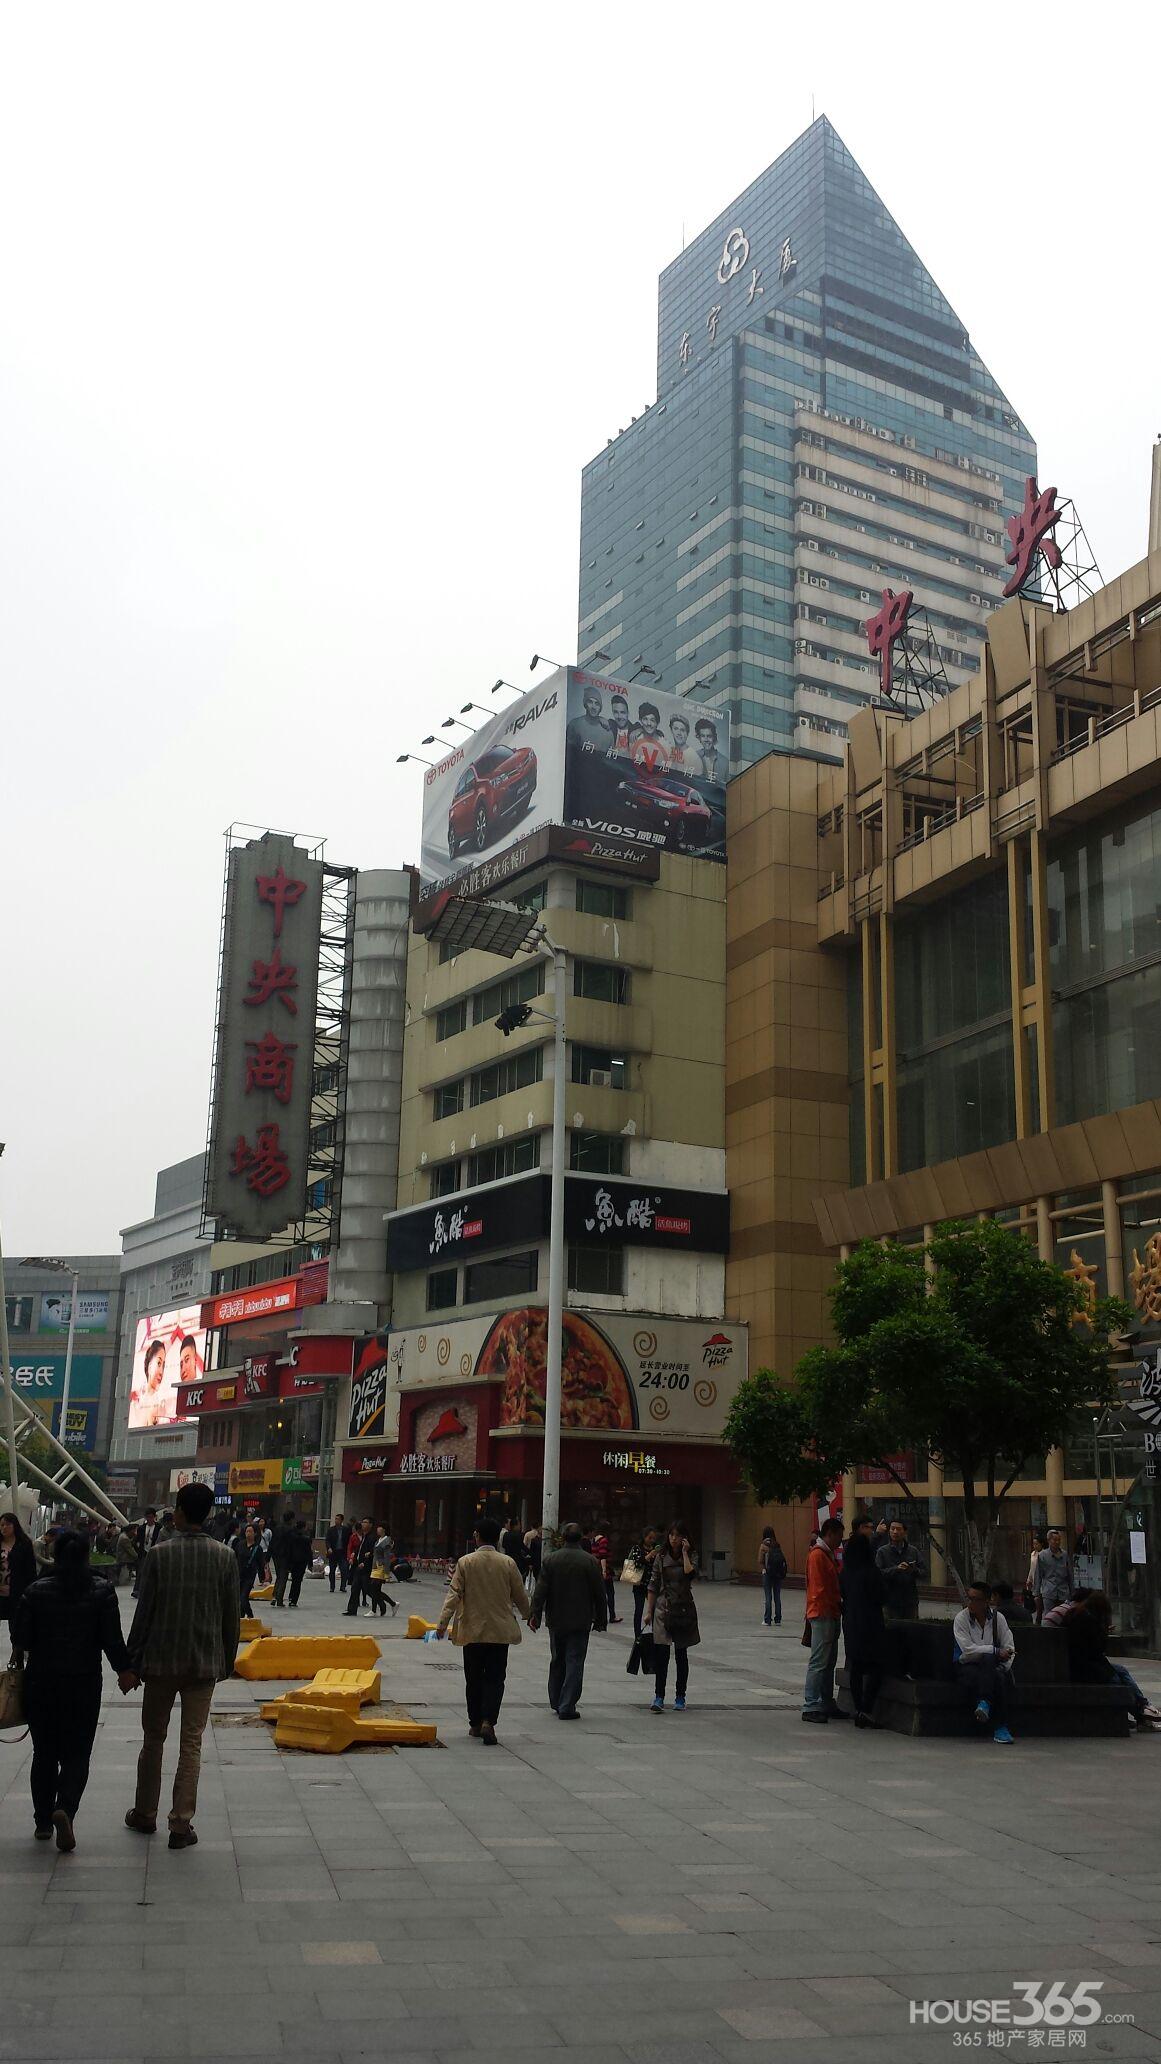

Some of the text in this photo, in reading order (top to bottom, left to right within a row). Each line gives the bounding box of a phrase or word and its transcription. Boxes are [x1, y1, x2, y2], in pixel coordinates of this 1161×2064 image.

[589, 678, 629, 697] TOYOTA
[513, 691, 558, 735] RAV4
[437, 749, 466, 778] TOYOTA
[585, 817, 637, 838] VIOS
[591, 843, 648, 863] Pizza Hut
[459, 845, 528, 896] 必胜客欢乐餐厅
[703, 1347, 733, 1363] Pizza
[708, 1356, 729, 1368] Hut
[252, 1363, 268, 1378] KFC
[639, 1361, 690, 1372] 延长营业时间至
[639, 1371, 690, 1390] 24:00
[186, 1389, 205, 1406] KFC
[350, 1365, 387, 1421] Pizza
[356, 1387, 384, 1431] Hut
[400, 1453, 456, 1473] 必胜客欢乐餐厅
[603, 1451, 656, 1473] 休闲早餐
